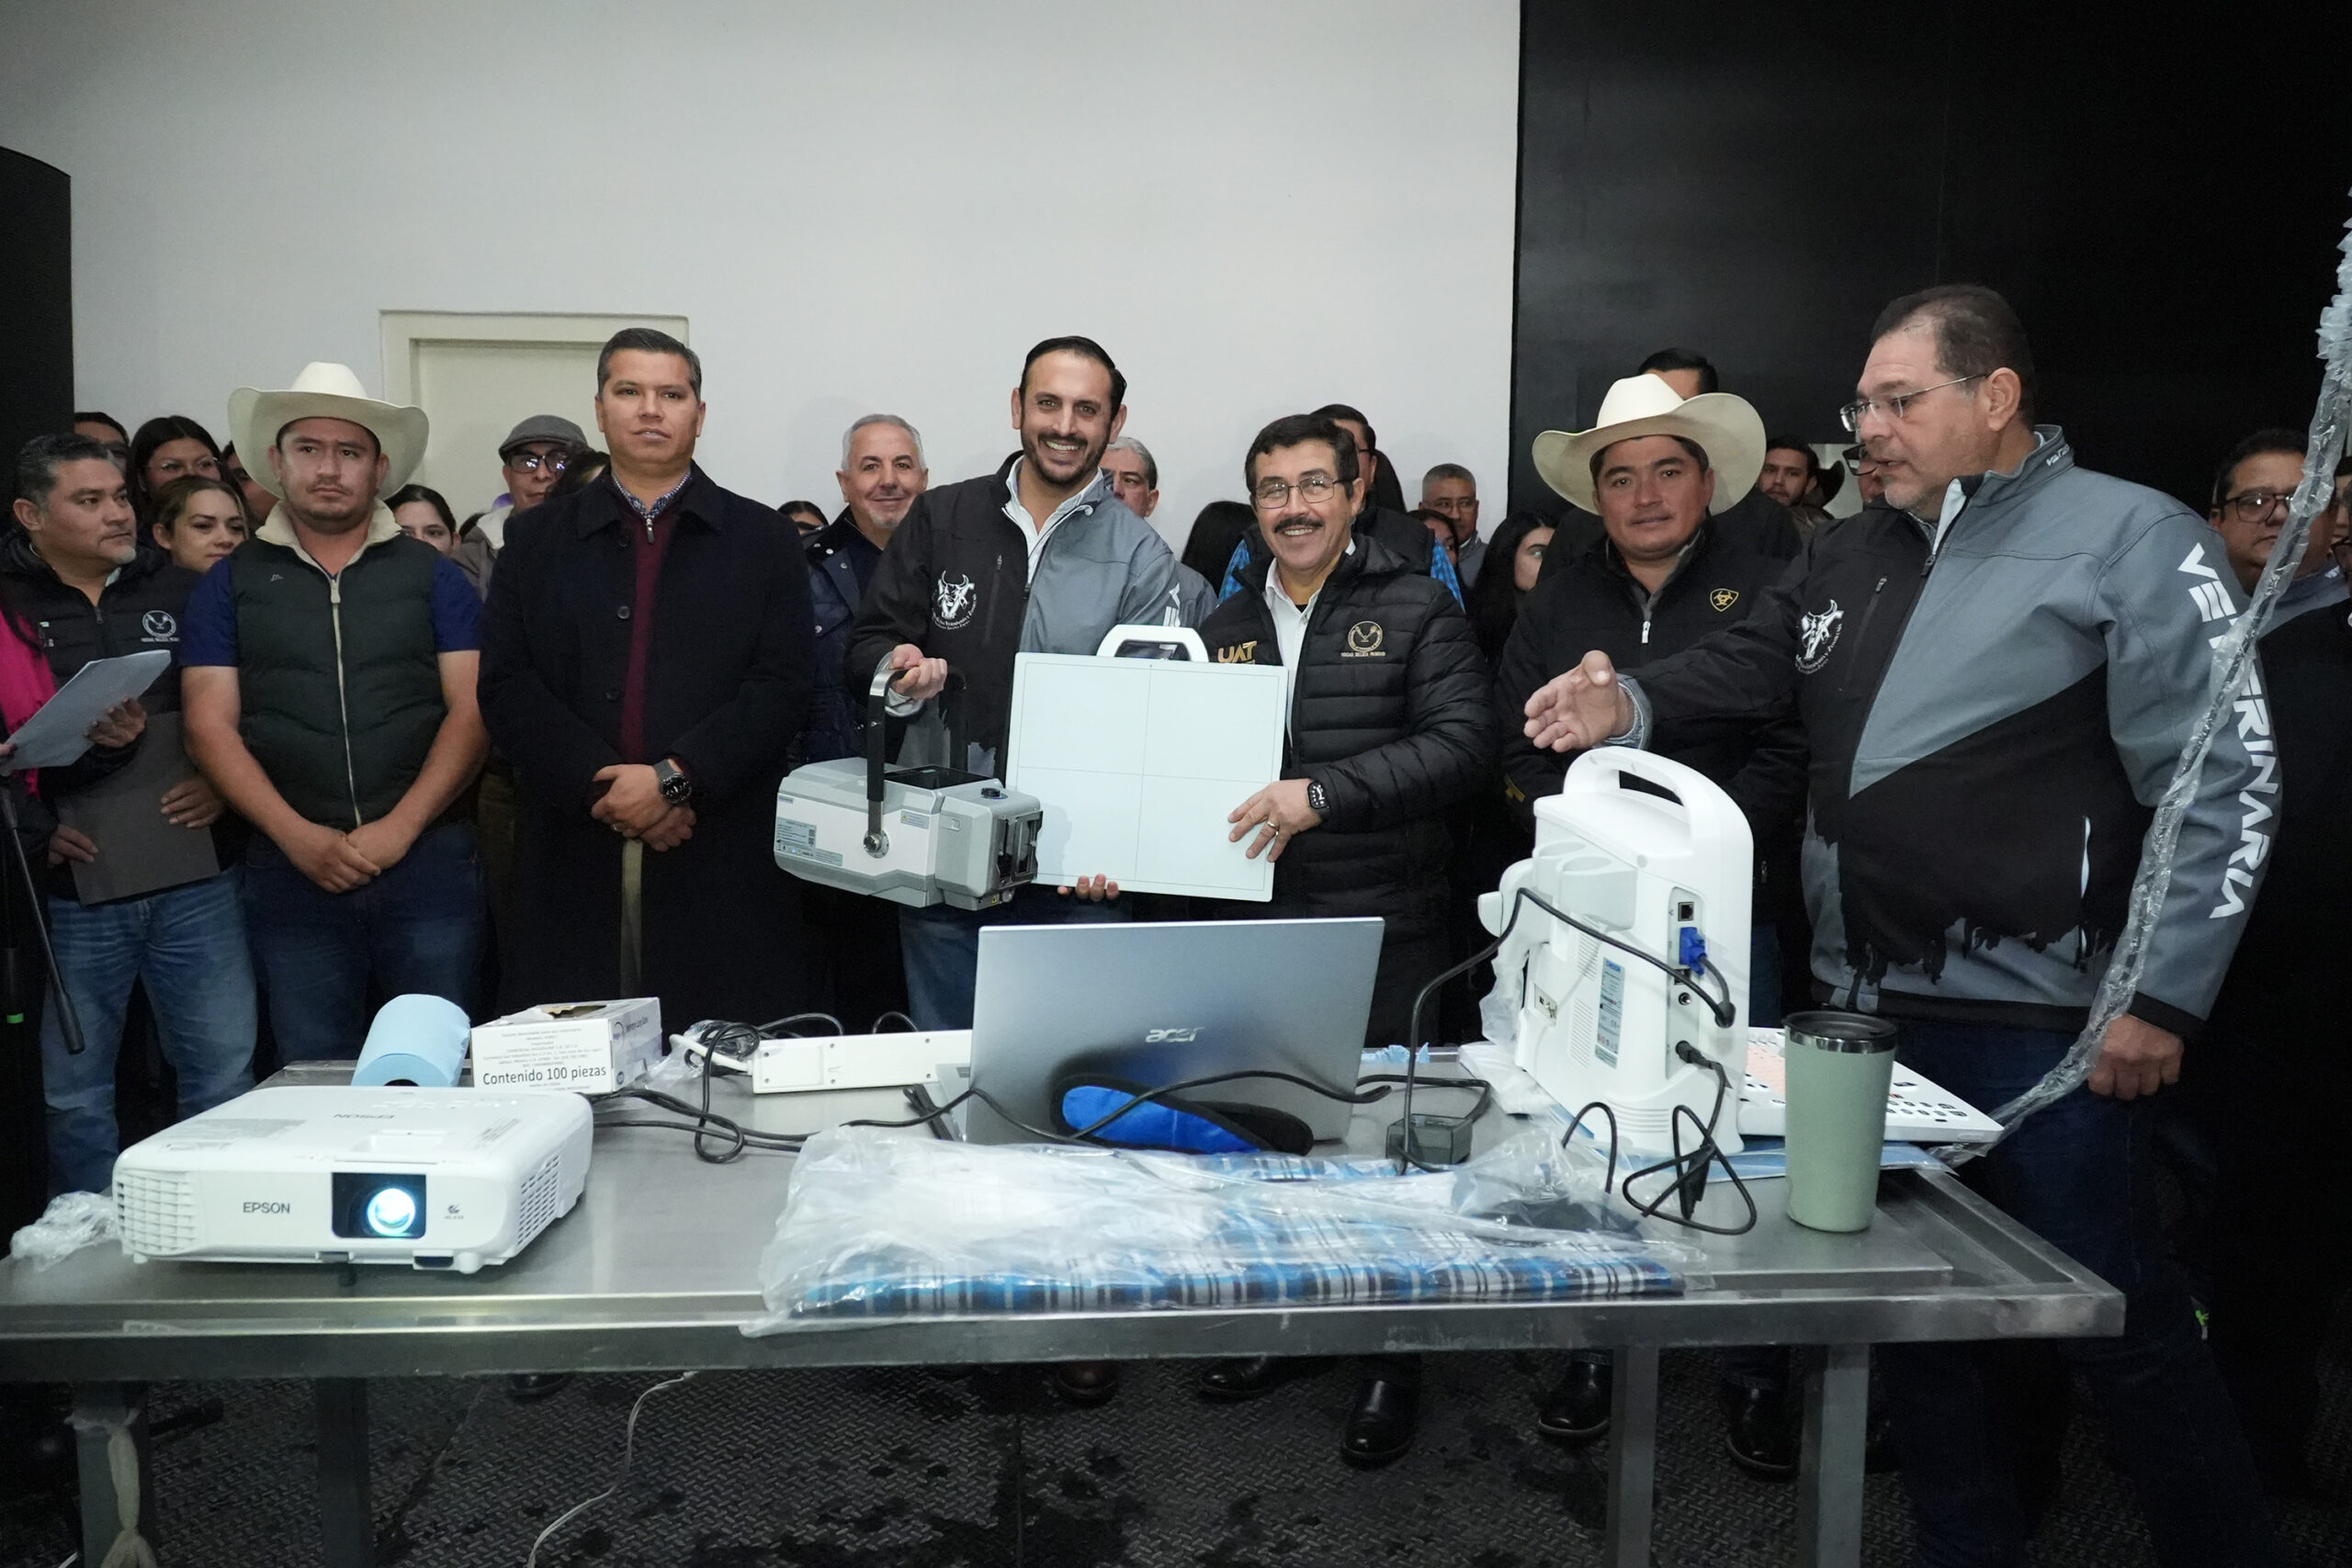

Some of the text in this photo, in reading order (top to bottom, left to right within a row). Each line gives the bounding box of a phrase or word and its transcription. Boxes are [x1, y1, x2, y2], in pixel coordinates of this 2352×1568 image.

[1217, 640, 1258, 663] UAT
[1145, 1027, 1205, 1043] acer
[482, 1065, 607, 1086] Contenido 100 piezas
[243, 1201, 291, 1214] EPSON
